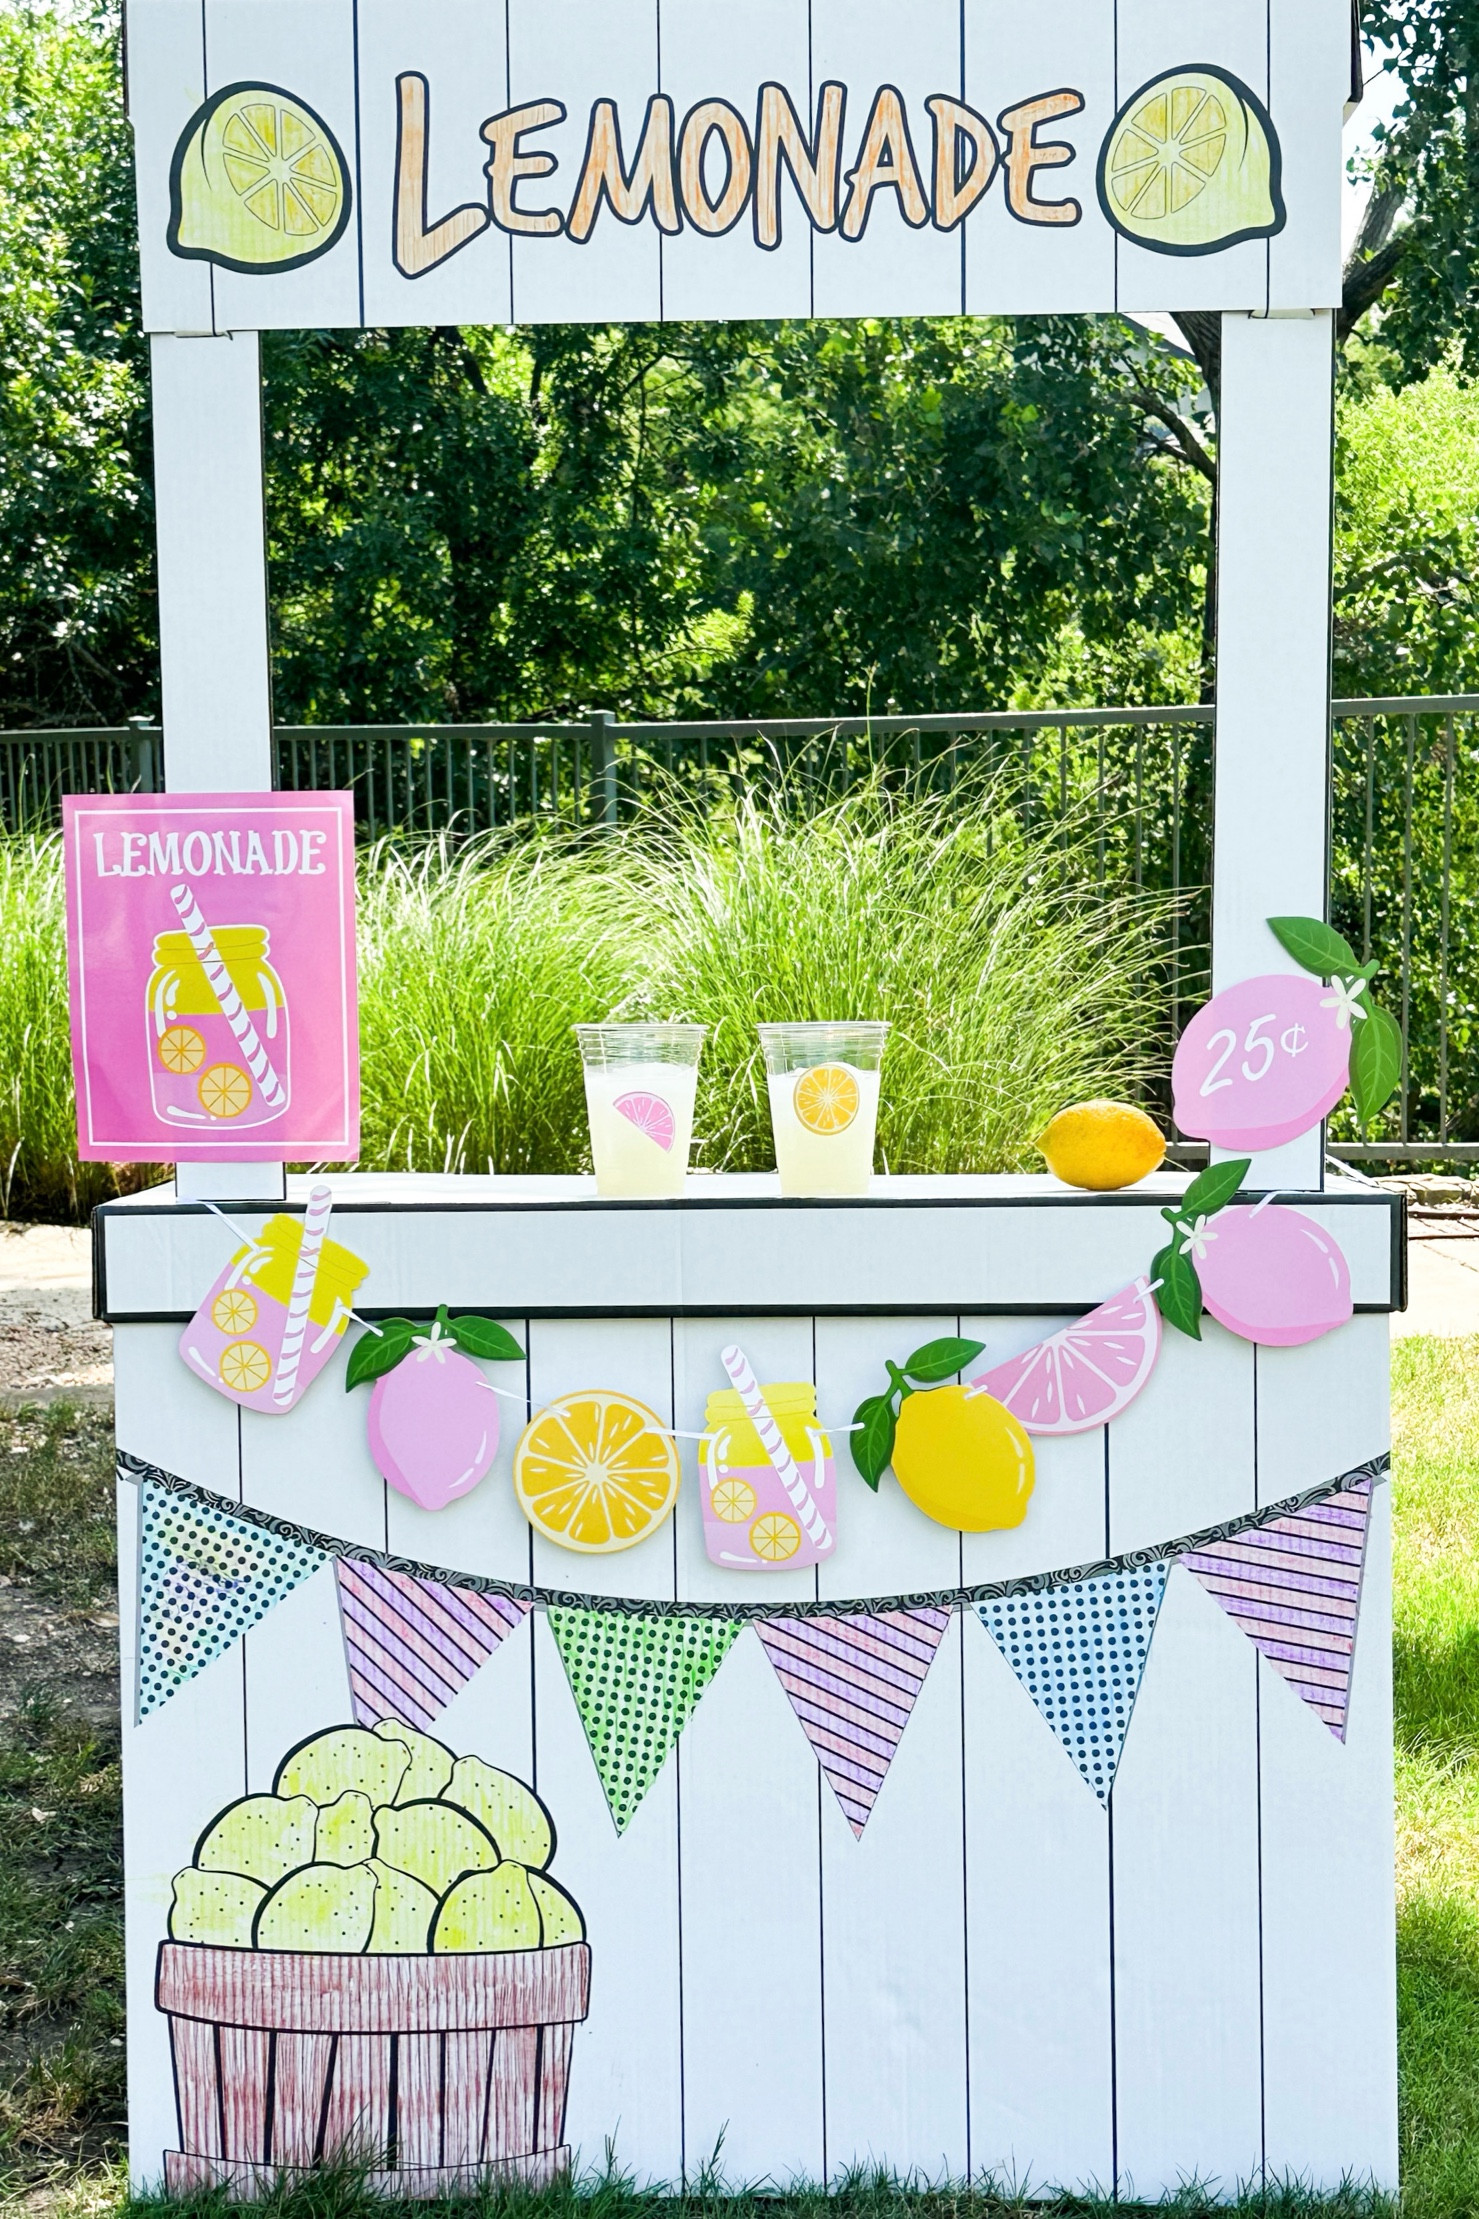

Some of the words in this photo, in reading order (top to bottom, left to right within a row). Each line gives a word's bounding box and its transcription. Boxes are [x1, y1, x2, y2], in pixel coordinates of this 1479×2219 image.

[393, 70, 1085, 279] LEMONADE
[93, 830, 327, 877] LEMONADE
[1200, 1013, 1308, 1097] 25¢
